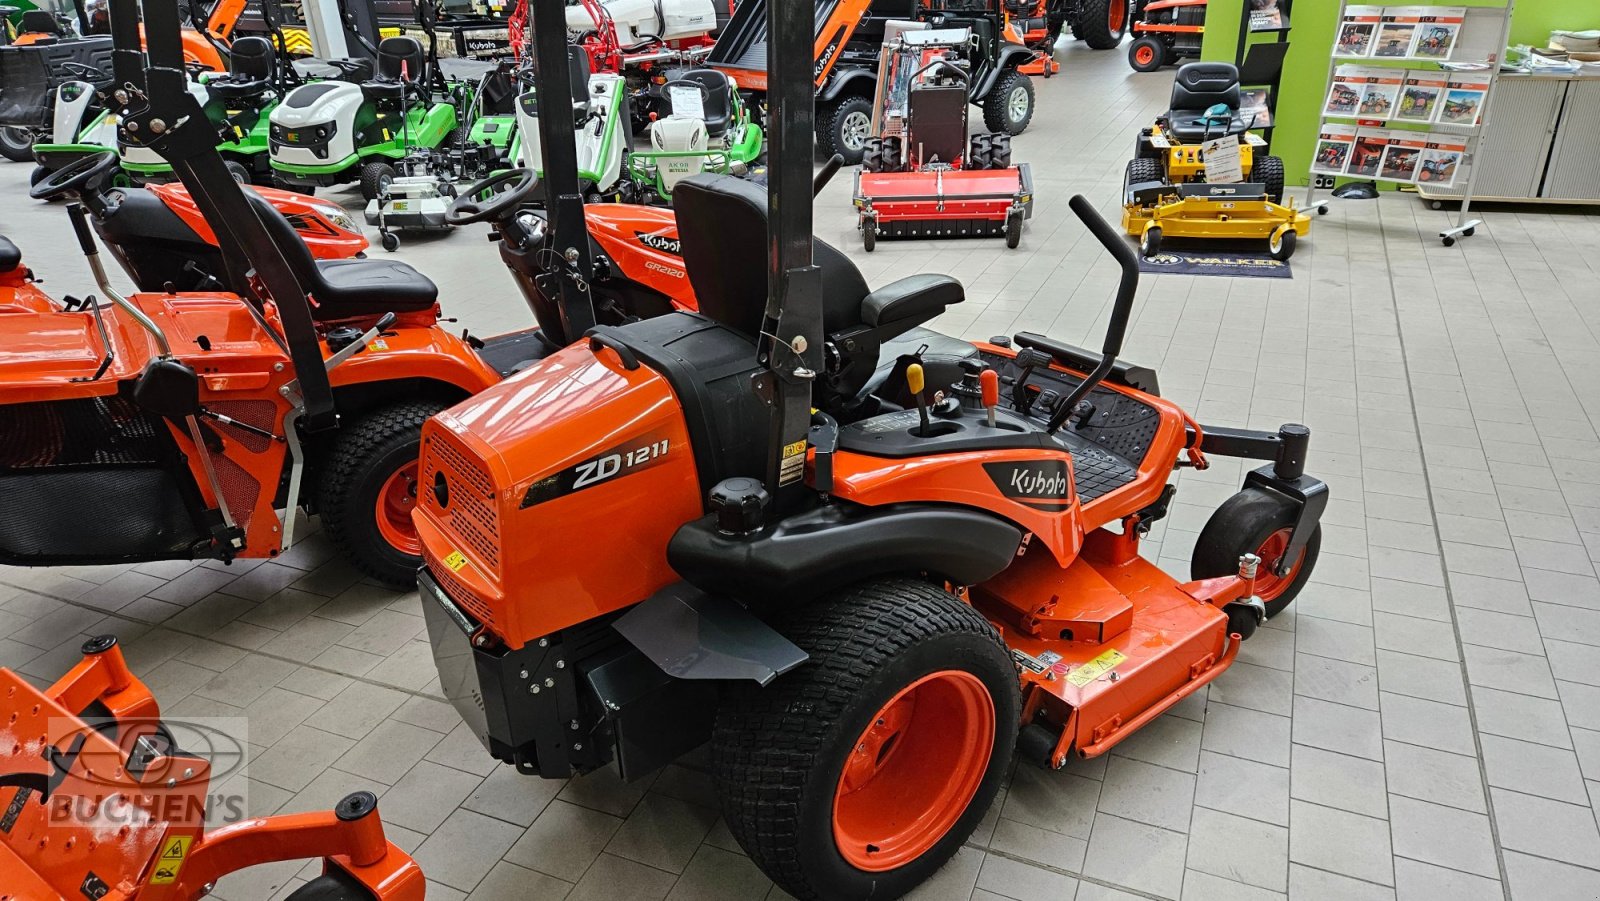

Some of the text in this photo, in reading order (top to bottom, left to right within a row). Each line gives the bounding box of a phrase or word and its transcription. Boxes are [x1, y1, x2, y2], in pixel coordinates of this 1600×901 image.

[469, 41, 496, 51] Kubota
[814, 44, 836, 76] Kubota
[644, 233, 681, 253] Kubot
[644, 261, 685, 279] GR2120
[1184, 256, 1285, 267] WALKER
[572, 439, 669, 489] ZD 1211
[1010, 468, 1066, 495] Kubota
